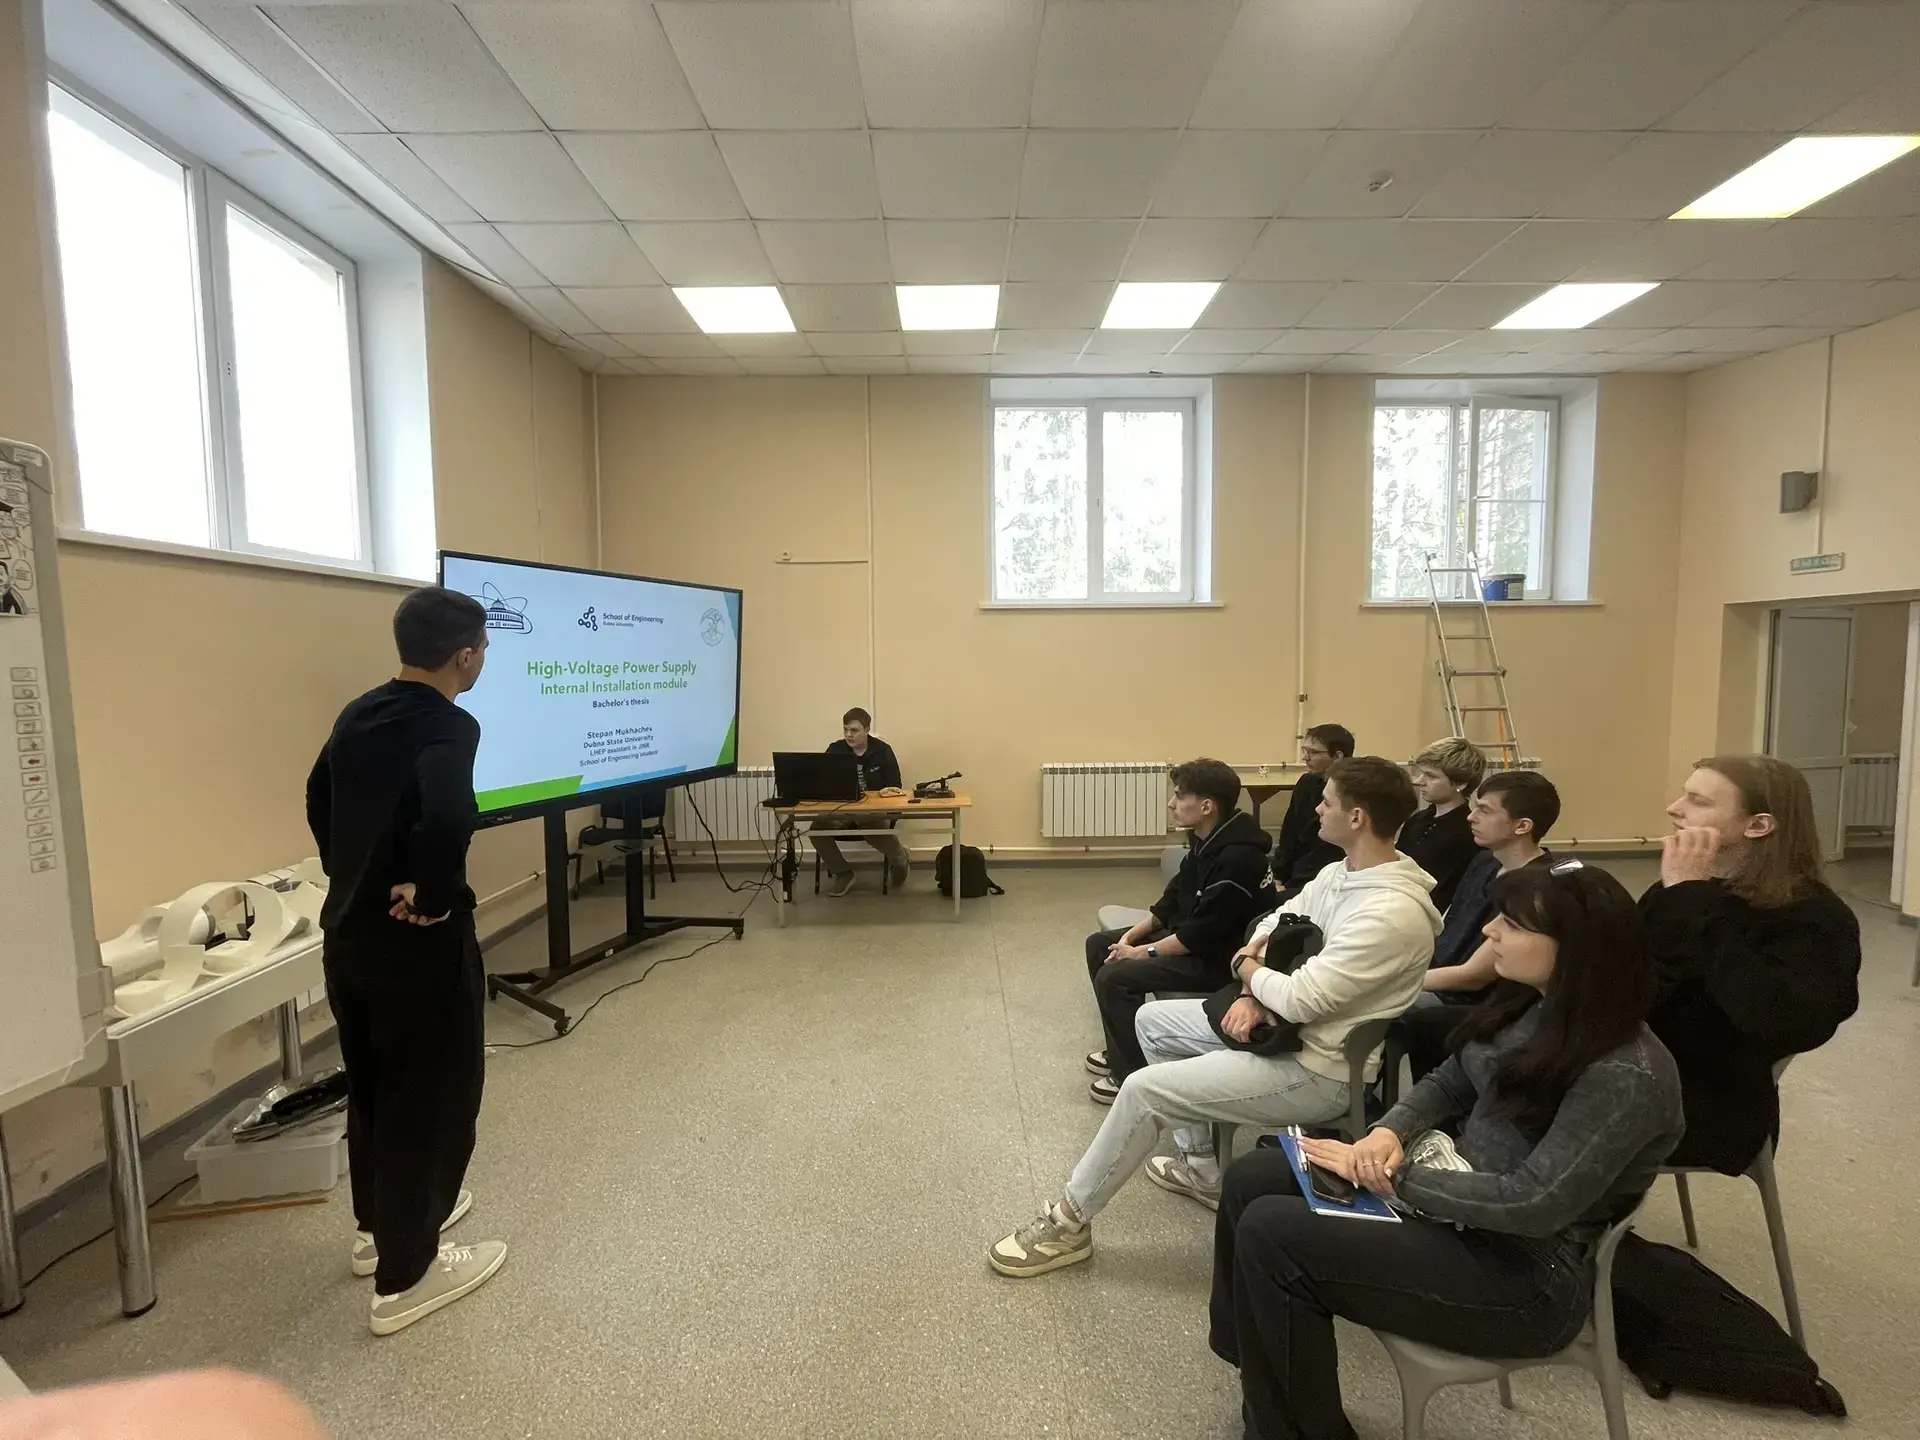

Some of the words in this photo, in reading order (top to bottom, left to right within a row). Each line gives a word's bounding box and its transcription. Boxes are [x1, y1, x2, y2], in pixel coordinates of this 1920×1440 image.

[603, 613, 623, 621] School
[632, 615, 664, 624] Engineering
[527, 660, 619, 678] High-Voltage
[623, 661, 659, 673] Power
[662, 660, 697, 676] Supply
[541, 681, 589, 695] Internal
[592, 679, 651, 693] Installation
[653, 678, 688, 690] module
[592, 698, 630, 708] Bachelor's
[631, 697, 650, 706] thesis
[587, 730, 614, 740] Stepan
[615, 726, 653, 736] Mukhachev
[583, 740, 605, 749] Dubna
[606, 738, 624, 746] State
[624, 735, 654, 744] University
[607, 745, 631, 754] assistant
[579, 757, 600, 767] School
[607, 752, 640, 763] Engineering
[640, 750, 659, 758] student
